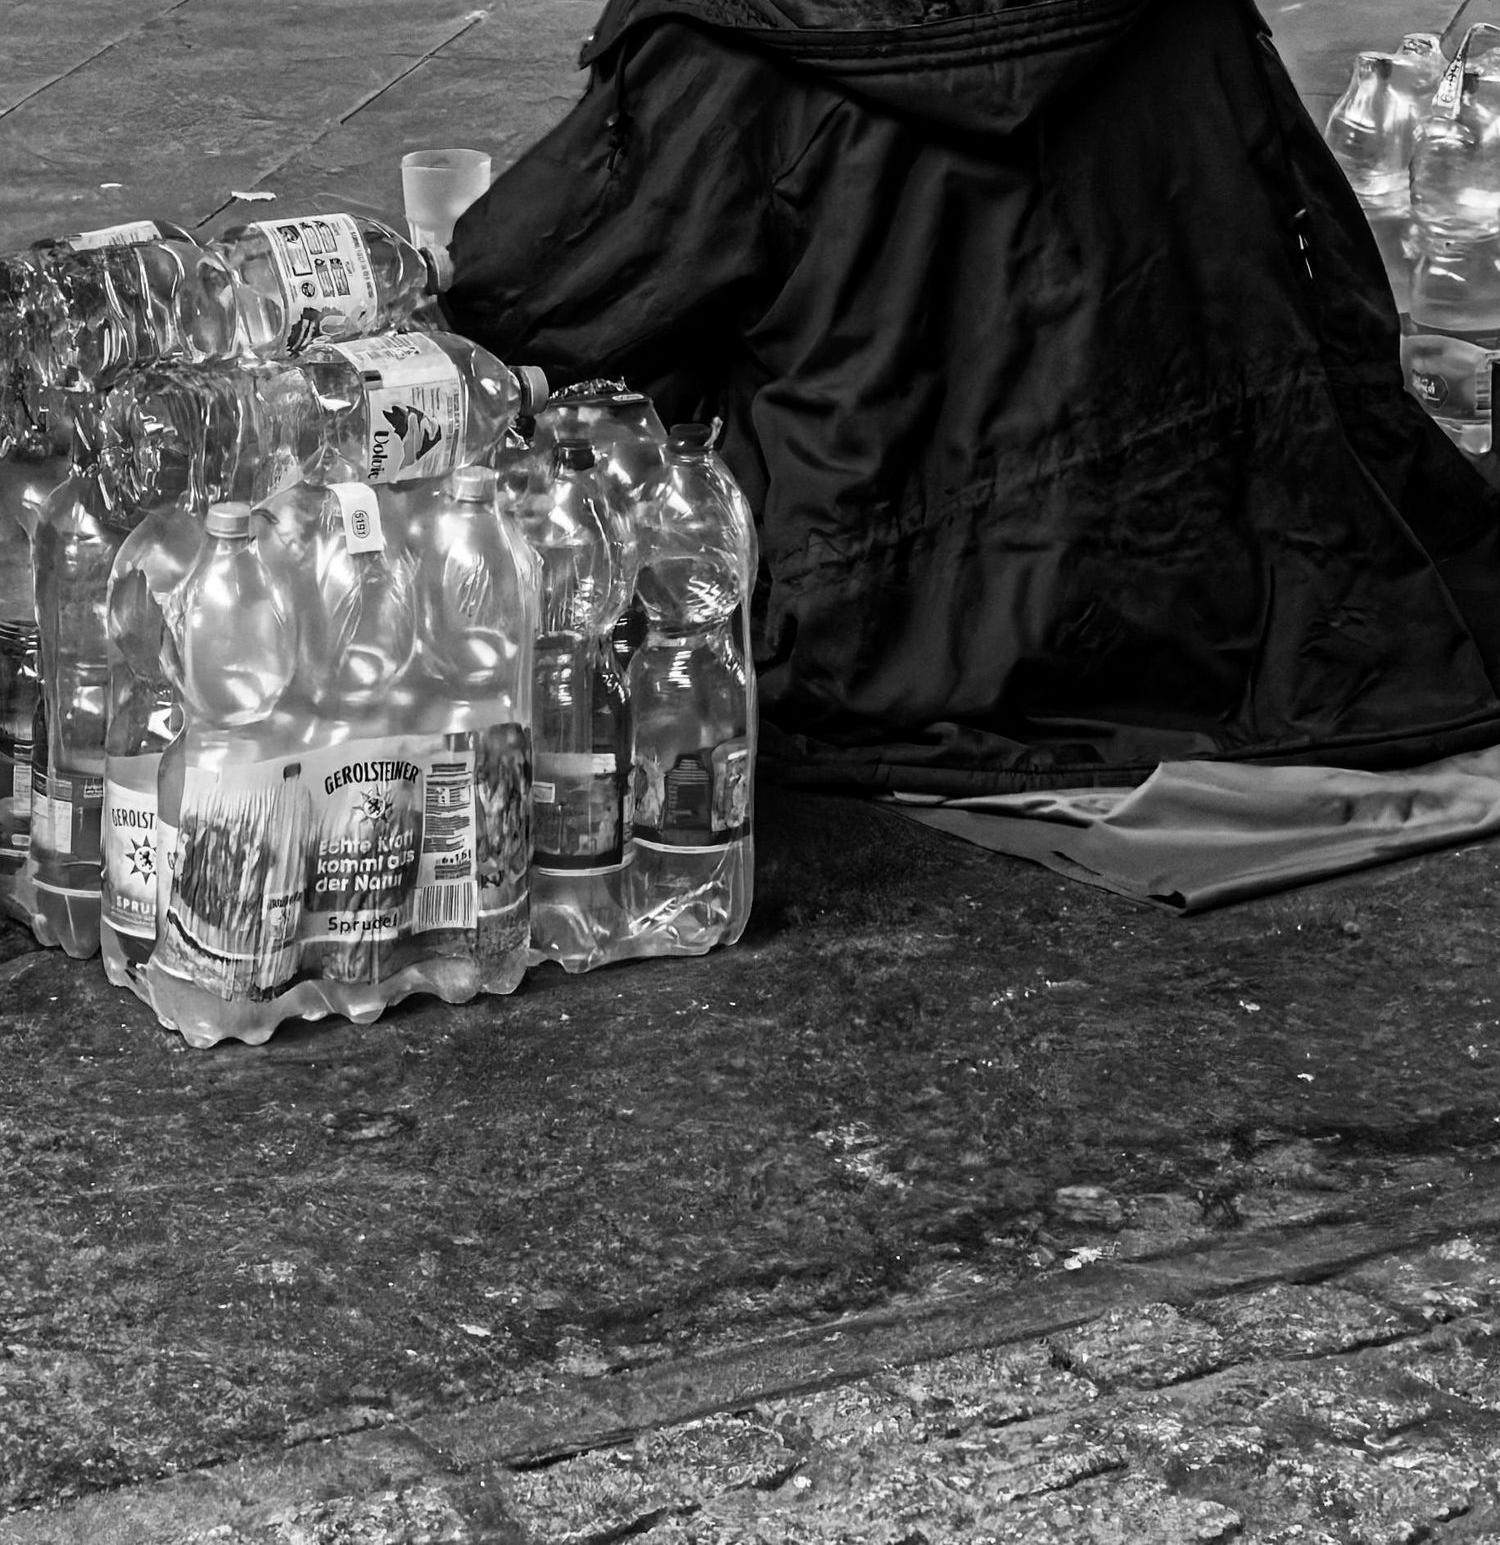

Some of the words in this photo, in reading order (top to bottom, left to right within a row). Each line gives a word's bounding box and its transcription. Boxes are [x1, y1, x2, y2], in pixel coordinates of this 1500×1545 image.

[325, 760, 420, 795] GEROLSTEINER
[315, 875, 349, 893] der
[327, 913, 398, 934] Sprudel
